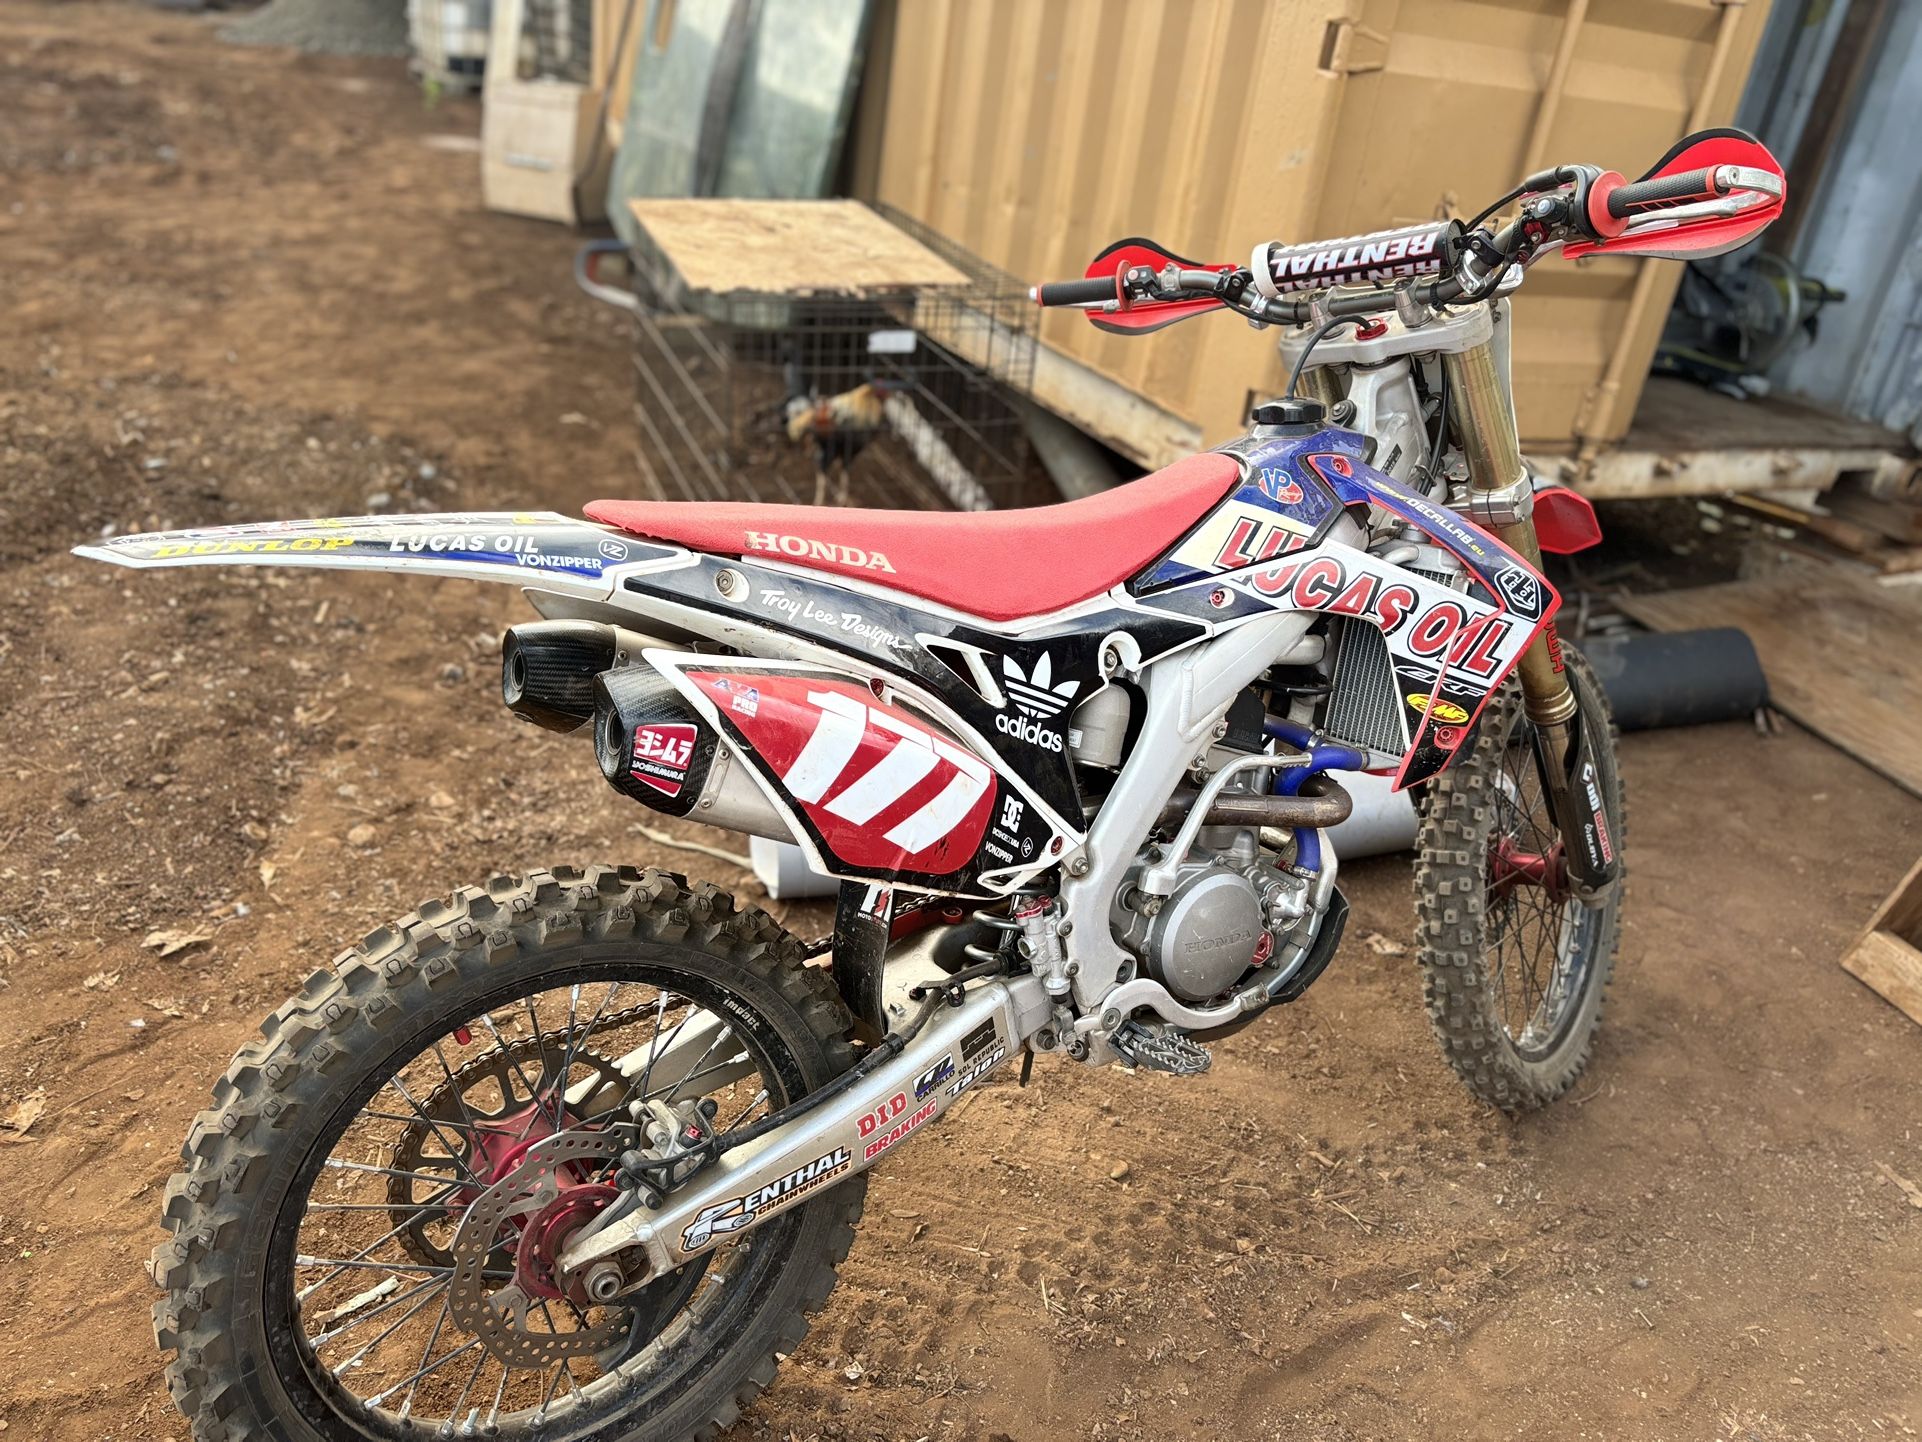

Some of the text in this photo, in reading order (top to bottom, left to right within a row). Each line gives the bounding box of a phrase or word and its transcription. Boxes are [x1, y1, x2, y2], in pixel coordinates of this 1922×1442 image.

[1270, 231, 1440, 278] RENTHAL
[1261, 467, 1292, 500] VP
[150, 536, 355, 558] DUNLOP
[389, 534, 539, 553] LUCAS OIL
[515, 553, 603, 570] VONZIPPER
[744, 530, 897, 574] HONDA
[1213, 515, 1514, 680] LUCAS OIL
[759, 589, 912, 650] Troy Lee Designs
[636, 729, 694, 766] ヨシムラ
[995, 713, 1063, 753] adidas
[631, 760, 686, 782] YOSHIMURA
[985, 841, 1014, 864] VONZIPPER
[1184, 928, 1252, 955] HONDA
[958, 1036, 1005, 1077] SOL REPUBLIC
[916, 1070, 956, 1103] CARRILLO
[863, 1097, 938, 1162] BRAKING
[757, 1161, 850, 1216] CHAINWHEELS
